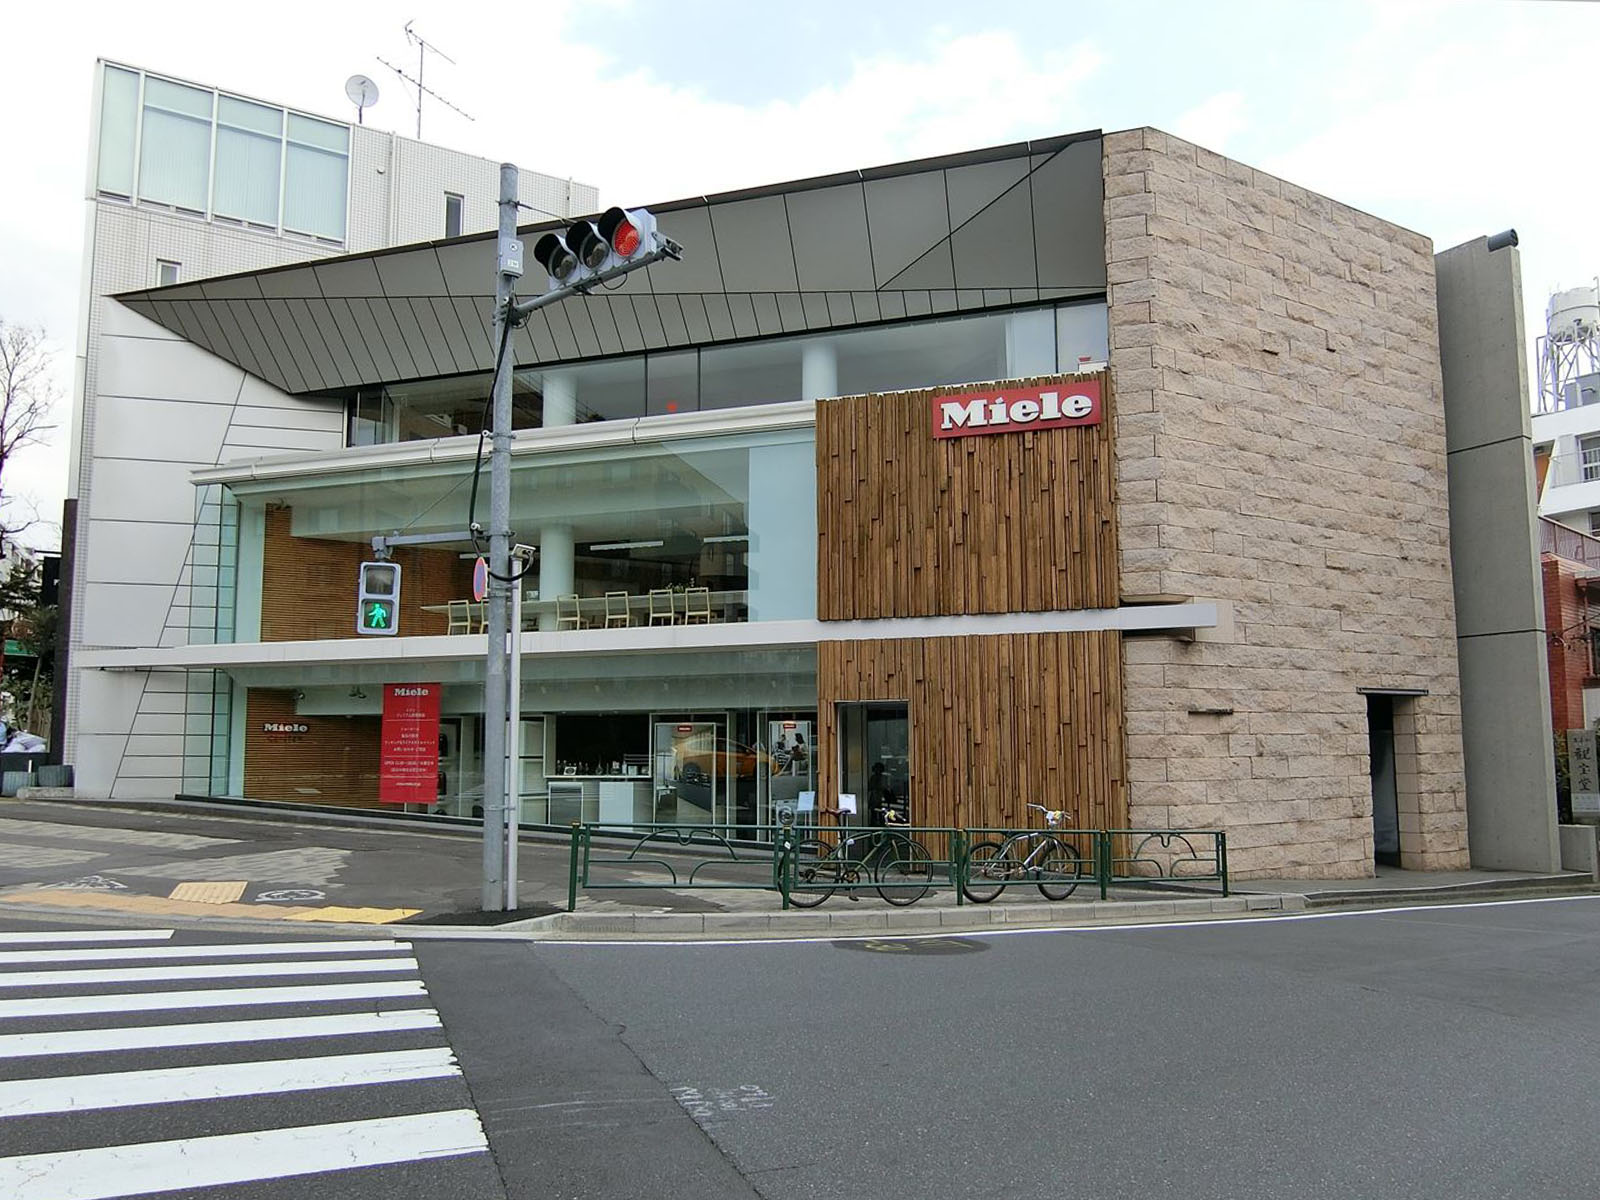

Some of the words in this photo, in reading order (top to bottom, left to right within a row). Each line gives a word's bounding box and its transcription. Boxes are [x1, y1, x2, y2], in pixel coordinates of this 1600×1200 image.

[940, 391, 1093, 430] Miele
[394, 687, 429, 696] Miele
[263, 723, 308, 732] Miele
